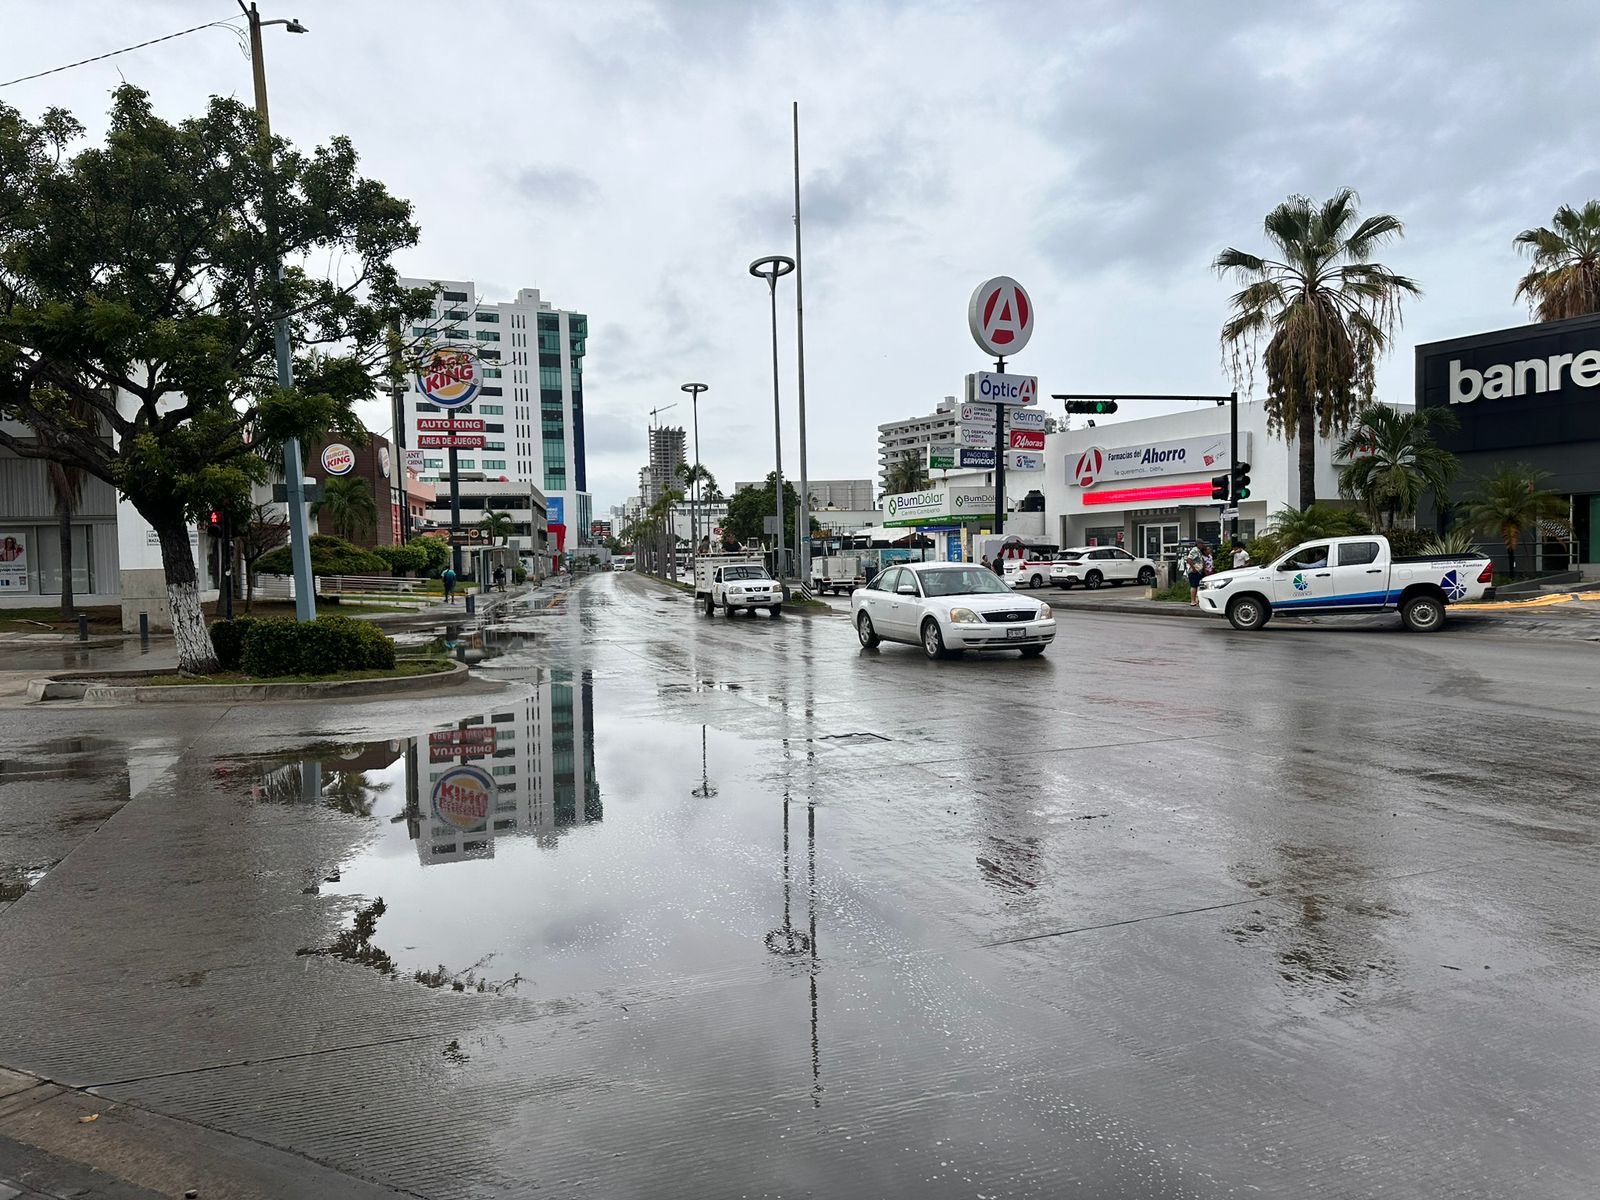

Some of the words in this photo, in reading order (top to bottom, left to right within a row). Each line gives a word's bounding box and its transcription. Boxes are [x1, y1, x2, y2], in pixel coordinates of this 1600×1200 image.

[426, 365, 473, 392] KING
[1012, 410, 1043, 423] derma
[420, 420, 451, 429] AUTO
[453, 420, 481, 429] KING
[442, 437, 452, 445] DE
[453, 437, 482, 446] JUEGOS
[326, 449, 349, 461] BURGER
[962, 457, 995, 465] SERVICIOS
[1108, 452, 1133, 461] Farmacias
[1133, 449, 1142, 459] del
[1141, 448, 1185, 464] Ahorro
[327, 456, 351, 468] KING
[897, 492, 944, 507] BumDólar
[901, 509, 917, 517] Centro
